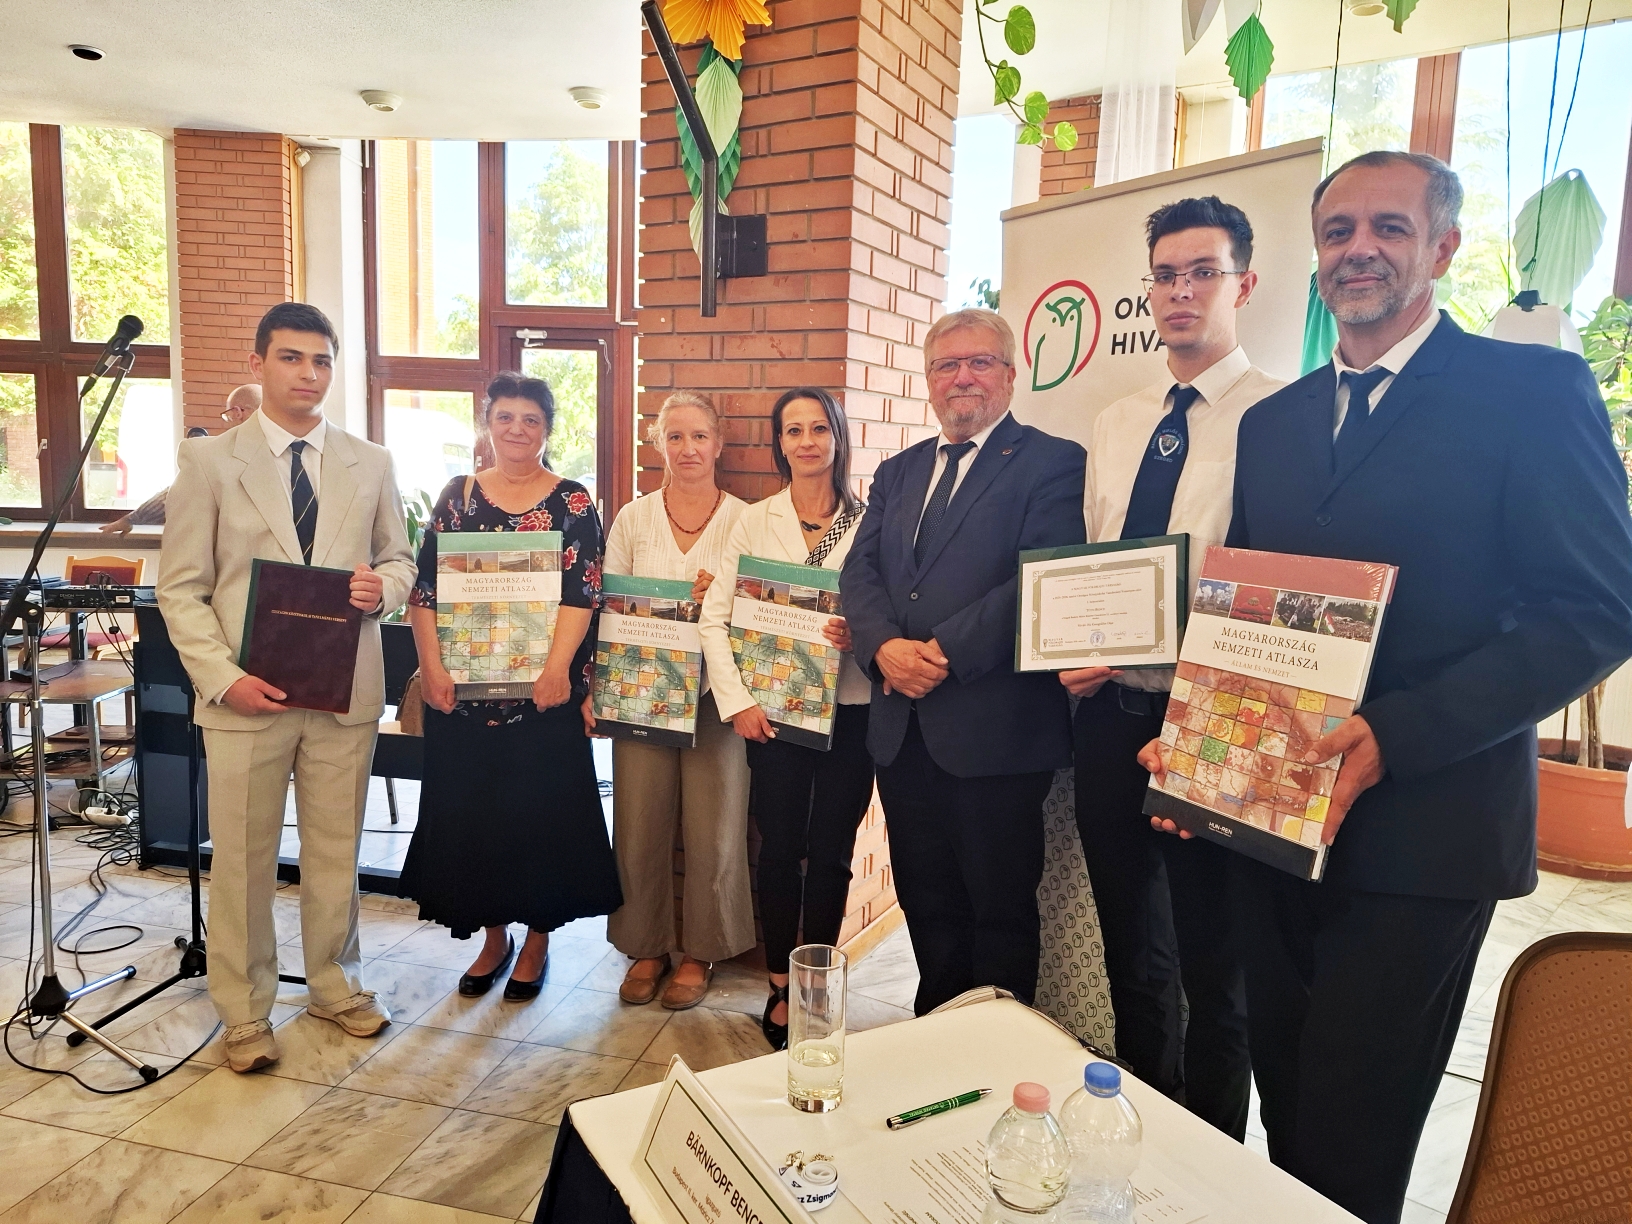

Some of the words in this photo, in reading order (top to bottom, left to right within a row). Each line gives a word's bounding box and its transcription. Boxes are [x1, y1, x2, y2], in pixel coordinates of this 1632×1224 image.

[465, 576, 532, 584] MAGYARORSZÁG
[758, 606, 818, 623] MAGYARORSZÁG
[621, 620, 677, 632] MAGYARORSZÁG
[753, 614, 786, 627] NEMZETI
[788, 621, 820, 633] ATLASZA
[617, 628, 648, 637] NEMZETI
[650, 631, 680, 641] ATLASZA
[1221, 627, 1317, 654] MAGYARORSZÁG
[1212, 640, 1263, 659] NEMZETI
[1266, 651, 1319, 671] ATLASZA
[1231, 661, 1253, 670] ÁLLAM
[1253, 663, 1261, 672] ÉS
[1262, 667, 1290, 679] NEMZET
[1208, 821, 1233, 835] HUN-REN
[685, 1130, 733, 1196] BÄRNKOPF
